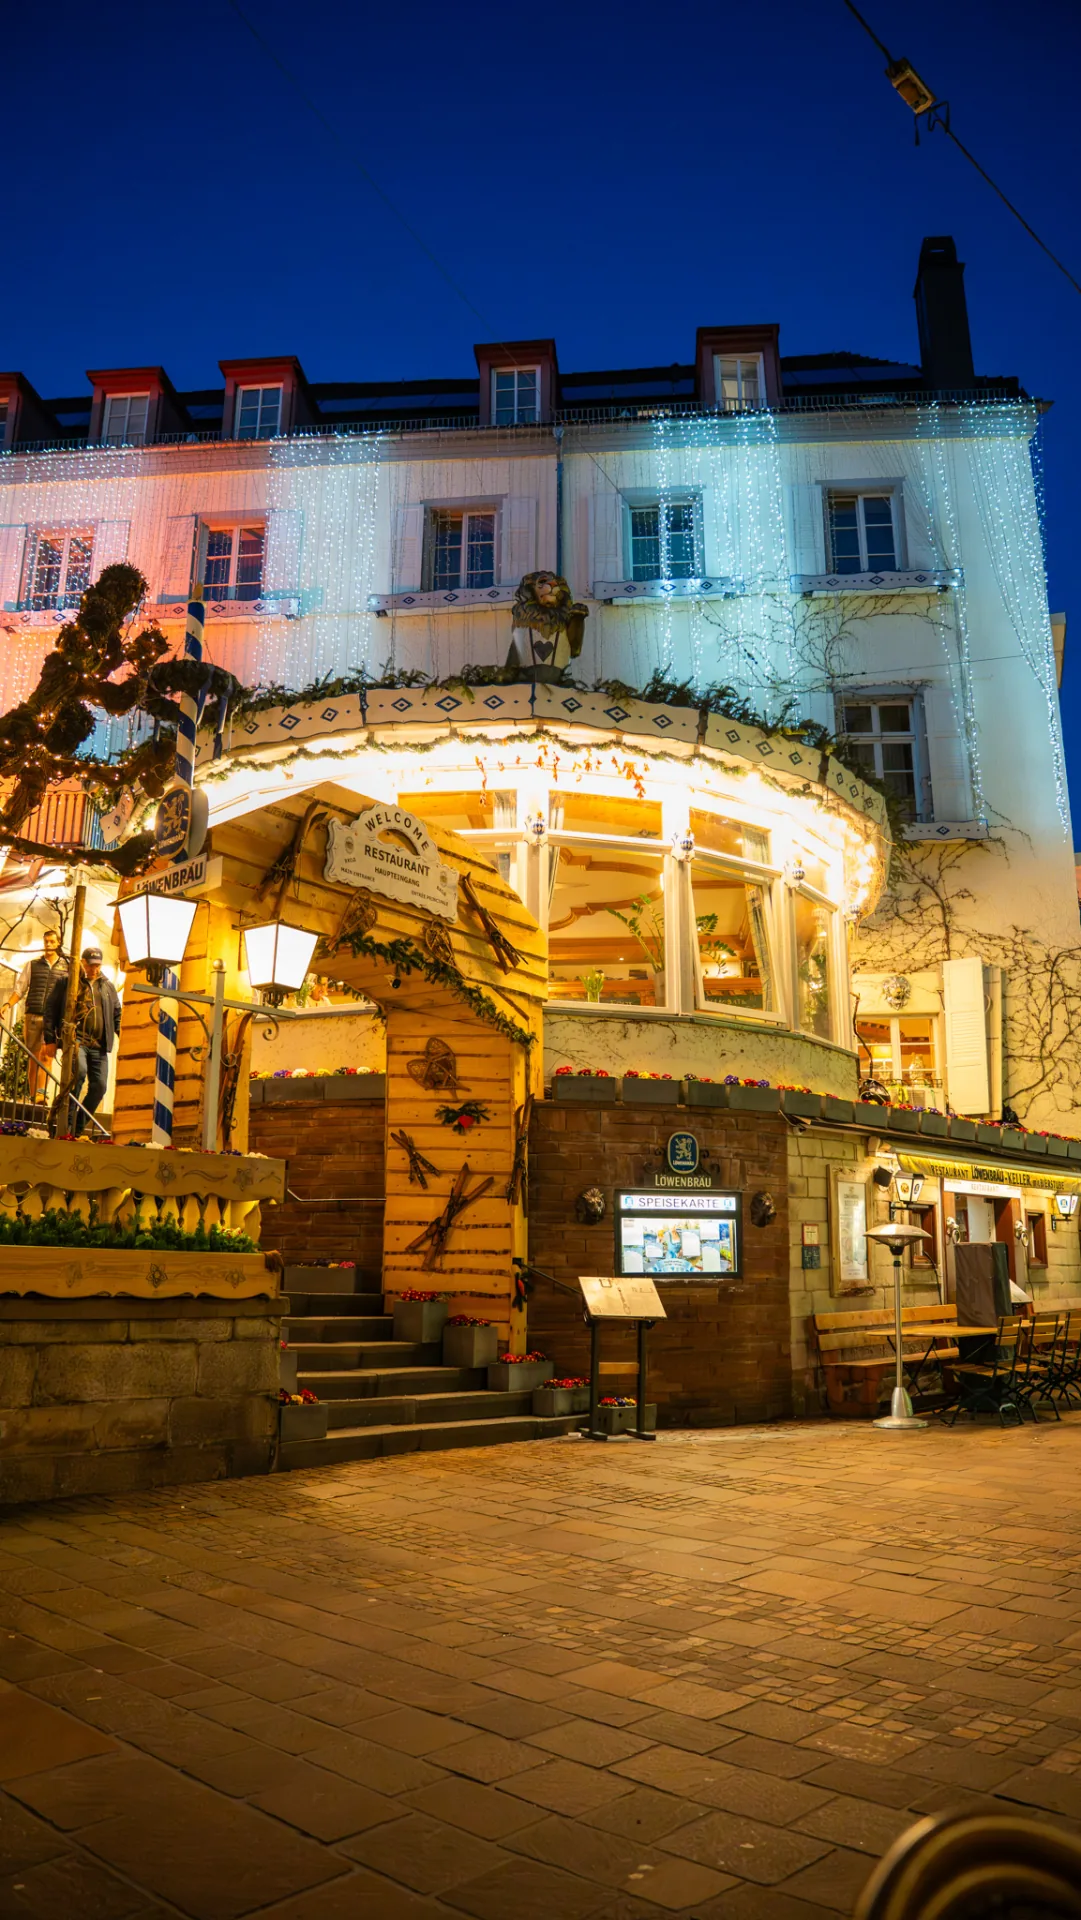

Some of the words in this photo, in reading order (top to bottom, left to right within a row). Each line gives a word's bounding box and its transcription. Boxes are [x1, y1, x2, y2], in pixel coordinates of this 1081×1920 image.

[365, 811, 430, 852] WELCOME
[364, 844, 431, 877] RESTAURANT
[374, 866, 421, 888] HAUPTEINGANG
[655, 1173, 712, 1188] LÖWENBRÄU
[930, 1165, 969, 1179] RESTAURANT
[638, 1197, 719, 1209] SPEISEKARTE
